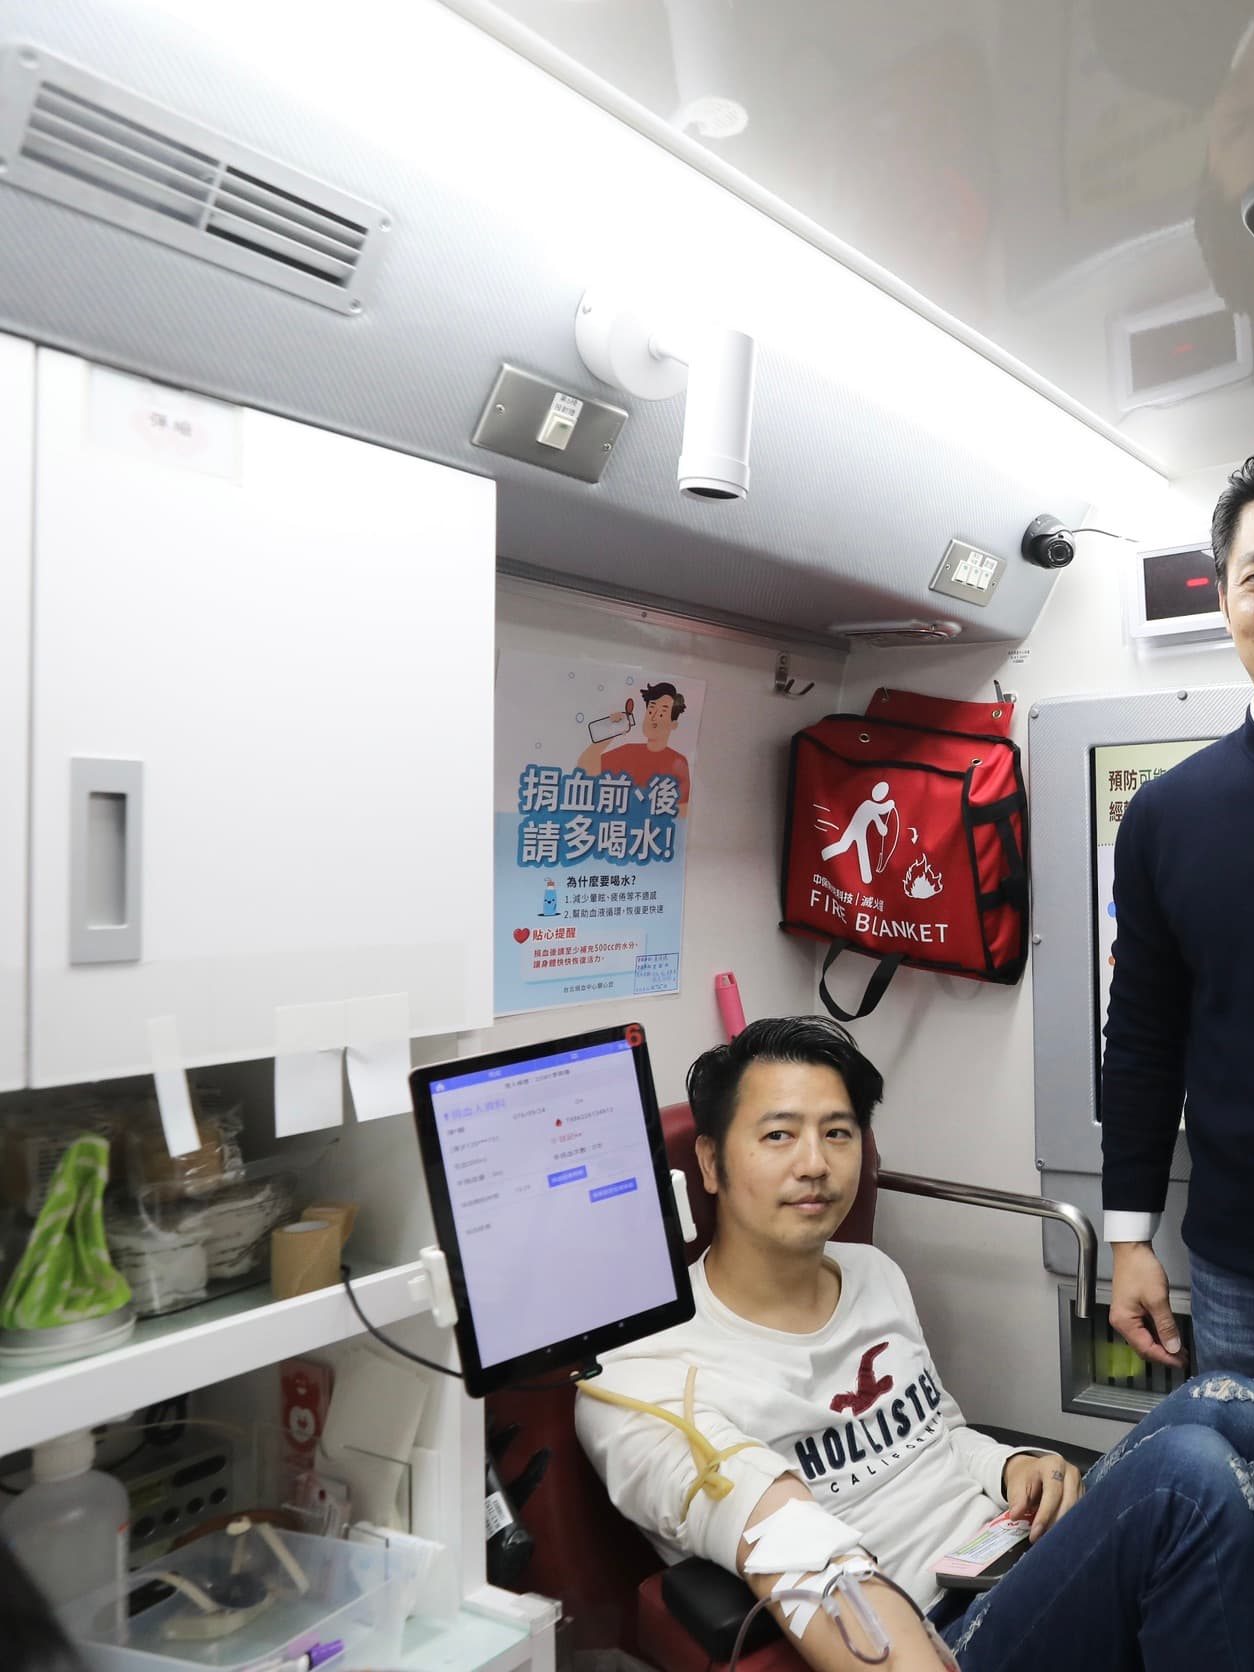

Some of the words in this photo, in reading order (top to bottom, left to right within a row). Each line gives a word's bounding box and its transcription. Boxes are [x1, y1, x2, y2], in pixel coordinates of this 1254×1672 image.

[522, 767, 679, 815] 捐血前、後
[1109, 801, 1130, 822] 經
[521, 815, 673, 863] 請多喝水!
[567, 875, 636, 888] 為什麼要喝水?
[810, 889, 847, 924] FIRE
[855, 912, 949, 943] BLANKET
[532, 927, 577, 941] 貼心提醒
[625, 1025, 643, 1047] 6
[794, 1368, 941, 1480] HOLLISTE
